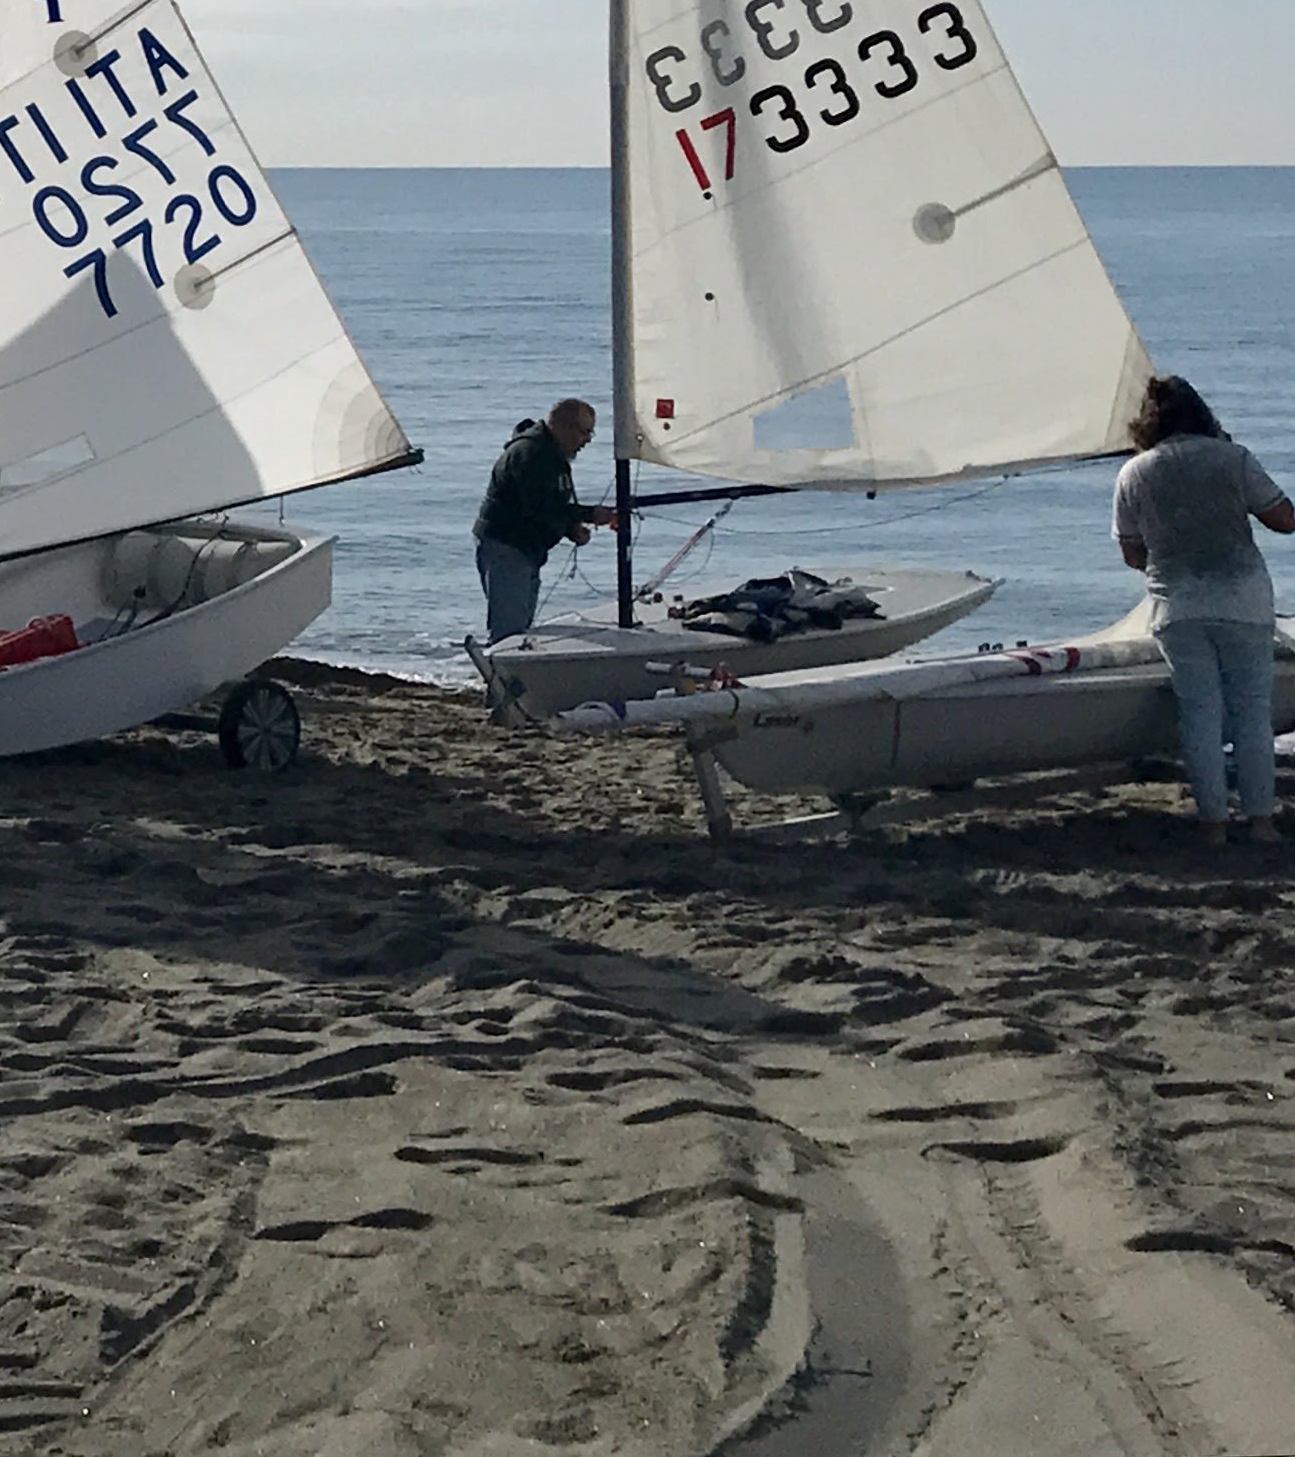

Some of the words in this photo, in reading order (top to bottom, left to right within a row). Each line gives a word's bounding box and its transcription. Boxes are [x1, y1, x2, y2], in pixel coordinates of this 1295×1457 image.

[64, 26, 190, 140] ITA
[675, 1, 978, 191] 173333
[63, 165, 258, 319] 7720
